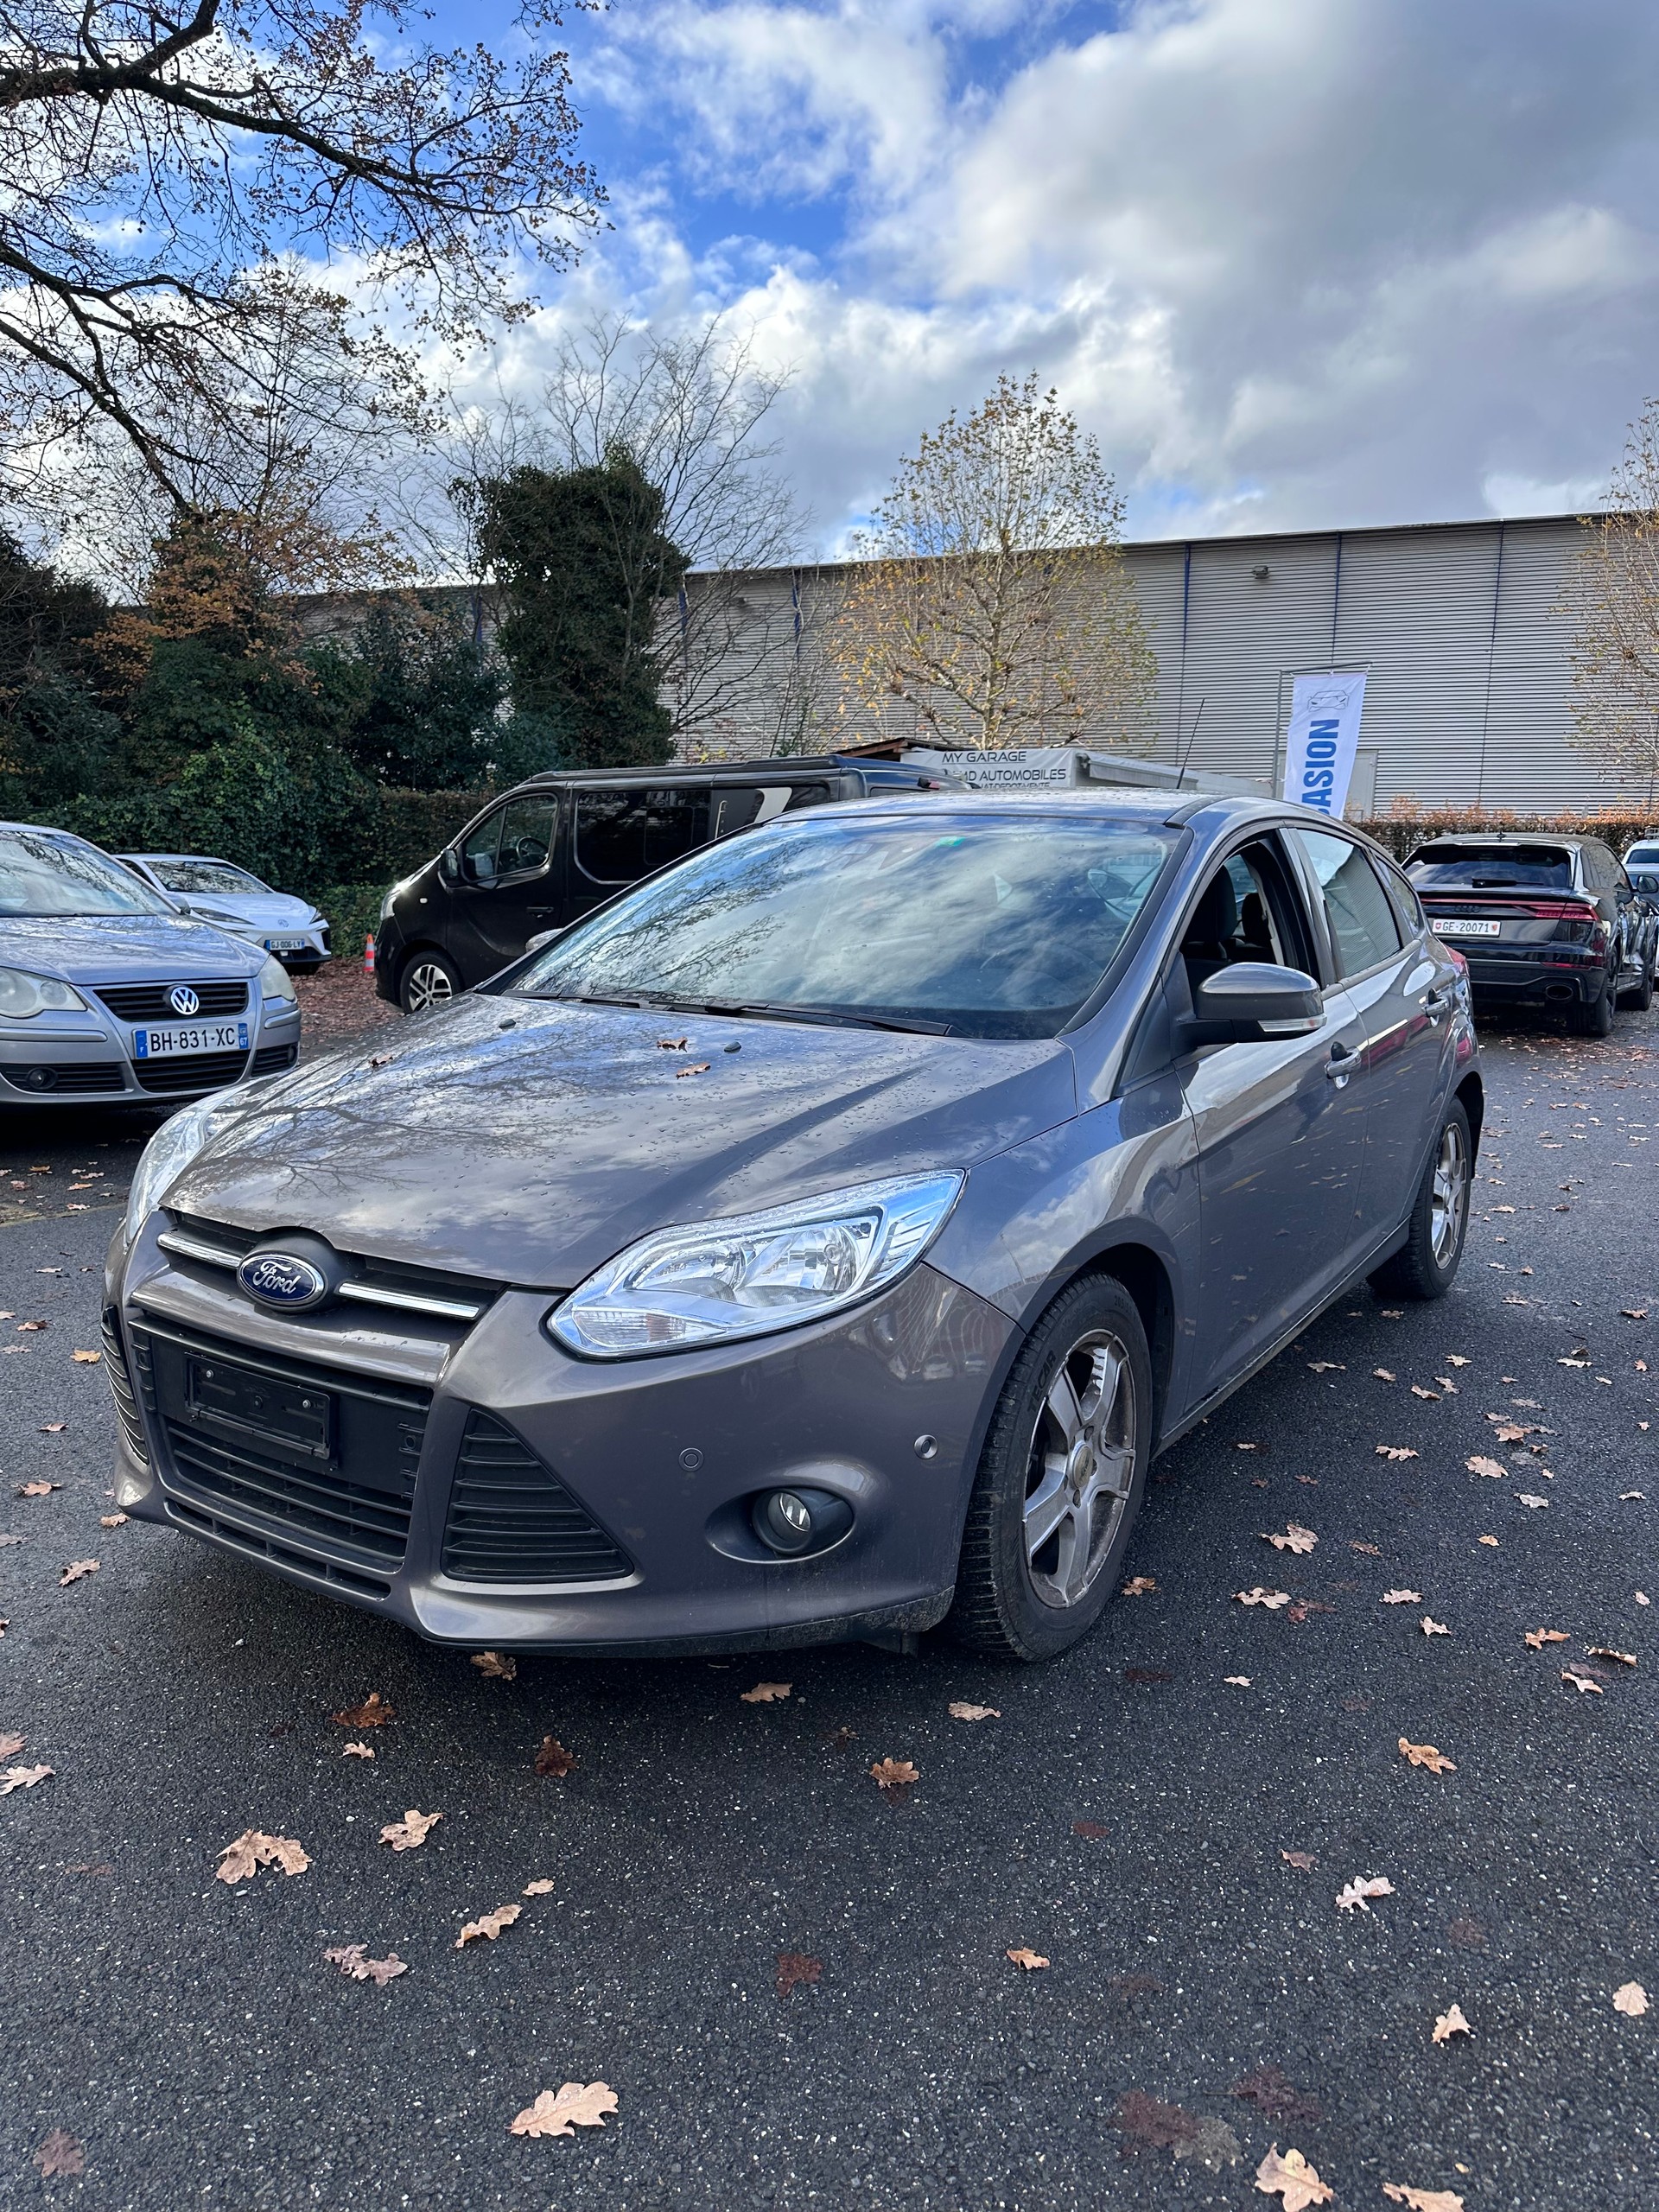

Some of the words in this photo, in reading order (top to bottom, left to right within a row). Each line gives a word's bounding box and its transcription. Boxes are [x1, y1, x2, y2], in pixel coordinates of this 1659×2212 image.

[942, 752, 963, 763] MY
[966, 751, 1027, 763] GARAGE
[1300, 719, 1339, 816] ASION
[979, 768, 1066, 781] AUTOMOBILES
[150, 1027, 235, 1052] BH-831-XC
[239, 1038, 248, 1046] 67
[252, 1261, 302, 1294] Ford
